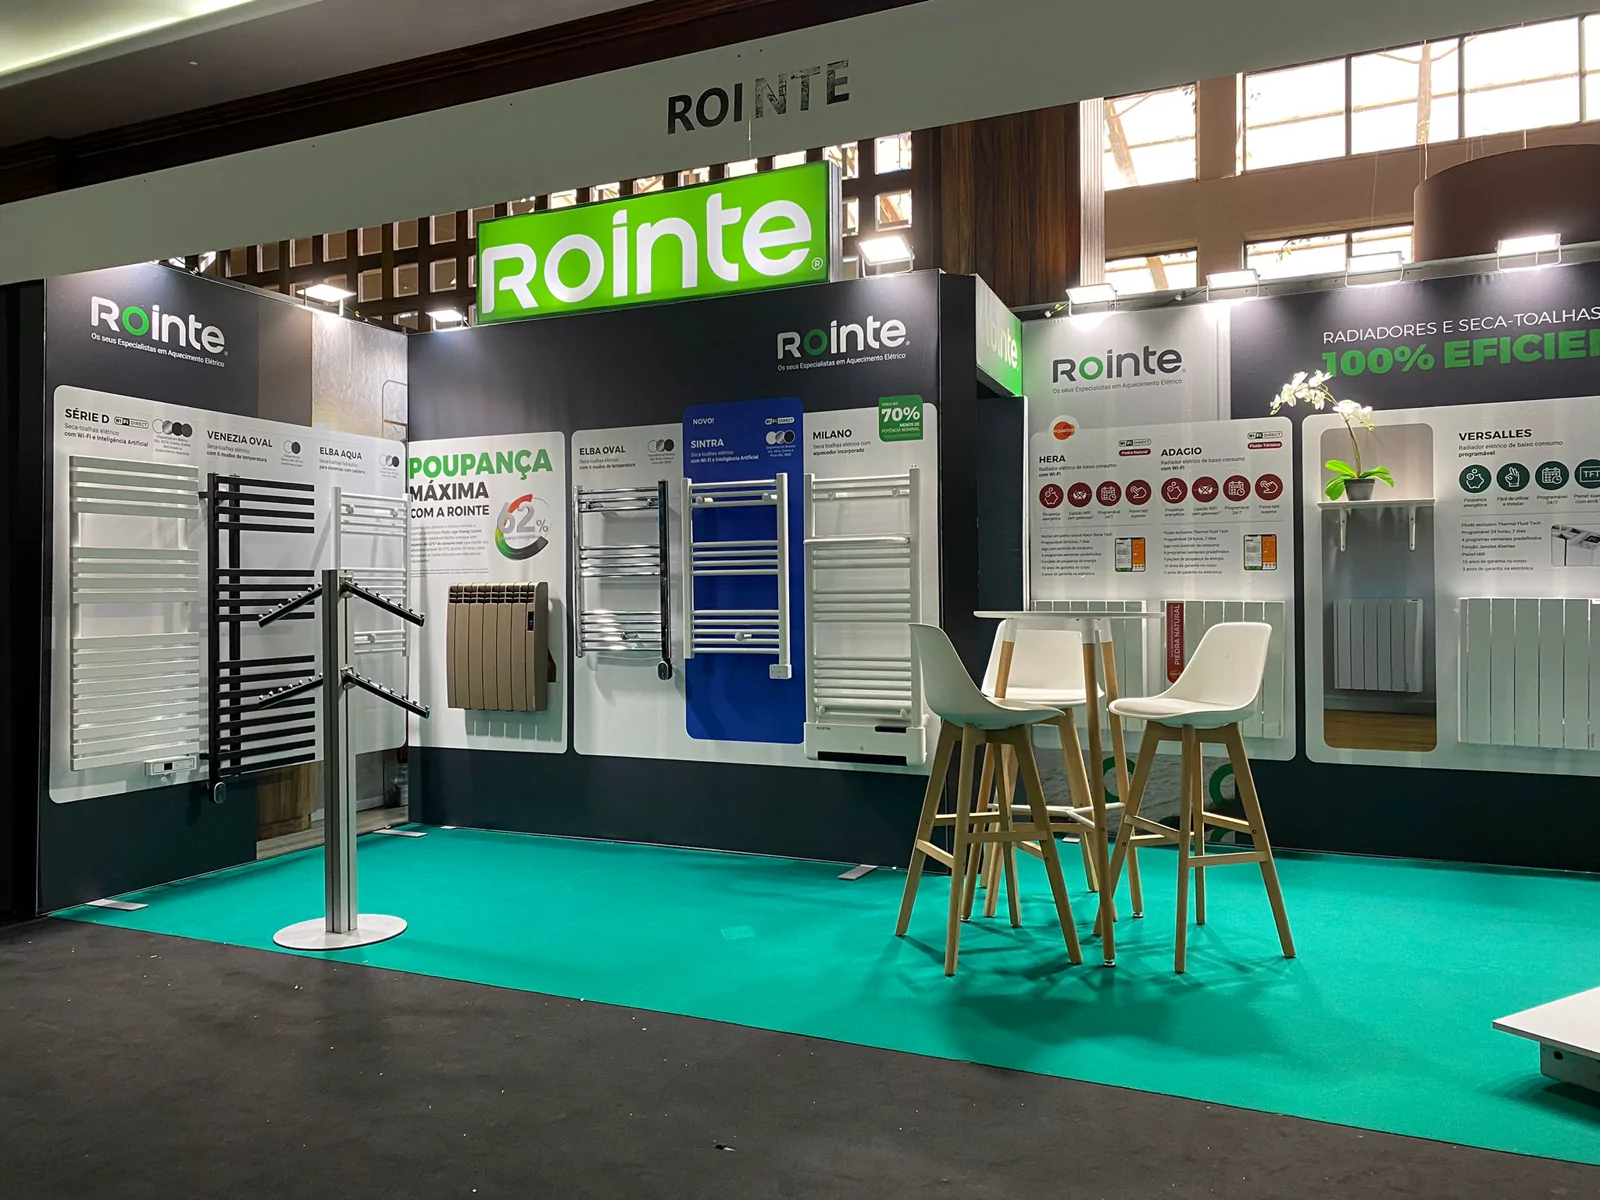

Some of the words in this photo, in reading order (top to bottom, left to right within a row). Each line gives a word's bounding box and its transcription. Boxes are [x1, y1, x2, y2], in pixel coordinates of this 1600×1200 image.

[667, 59, 850, 135] ROINTE
[1323, 322, 1436, 344] RADIADORES
[1443, 320, 1453, 333] E
[1458, 306, 1600, 332] SECA-TOALHAS
[102, 336, 116, 344] seus
[118, 338, 156, 353] Especialistas
[168, 350, 204, 364] Aquecimento
[205, 357, 224, 368] Elétrico
[800, 360, 835, 370] Especialistas
[846, 355, 883, 366] Aquecimento
[885, 352, 906, 361] Elétrico
[1322, 344, 1435, 377] 100%
[1076, 384, 1111, 393] Especialistas
[1122, 380, 1160, 389] Aquecimento
[1161, 378, 1182, 386] Elétrico
[65, 408, 98, 422] SÉRIE
[102, 414, 110, 424] D
[882, 406, 920, 422] 70%
[65, 423, 98, 433] Seca-toalhas
[100, 428, 119, 436] elétrico
[812, 429, 852, 440] MILANO
[1459, 428, 1532, 440] VERSALLES
[97, 436, 126, 445] Inteligência
[128, 439, 148, 447] Artificial
[208, 430, 248, 444] VENEZIA
[250, 436, 272, 447] OVAL
[690, 439, 724, 448] SINTRA
[320, 447, 340, 456] ELBA
[340, 450, 362, 460] AQUA
[580, 448, 600, 456] ELBA
[602, 446, 626, 454] OVAL
[1161, 447, 1202, 456] ADAGIO
[409, 449, 553, 480] POUPANÇA
[1039, 455, 1066, 463] HERA
[410, 480, 489, 502] MÁXIMA
[411, 507, 434, 518] COM
[436, 507, 448, 517] A
[448, 505, 490, 516] ROINTE
